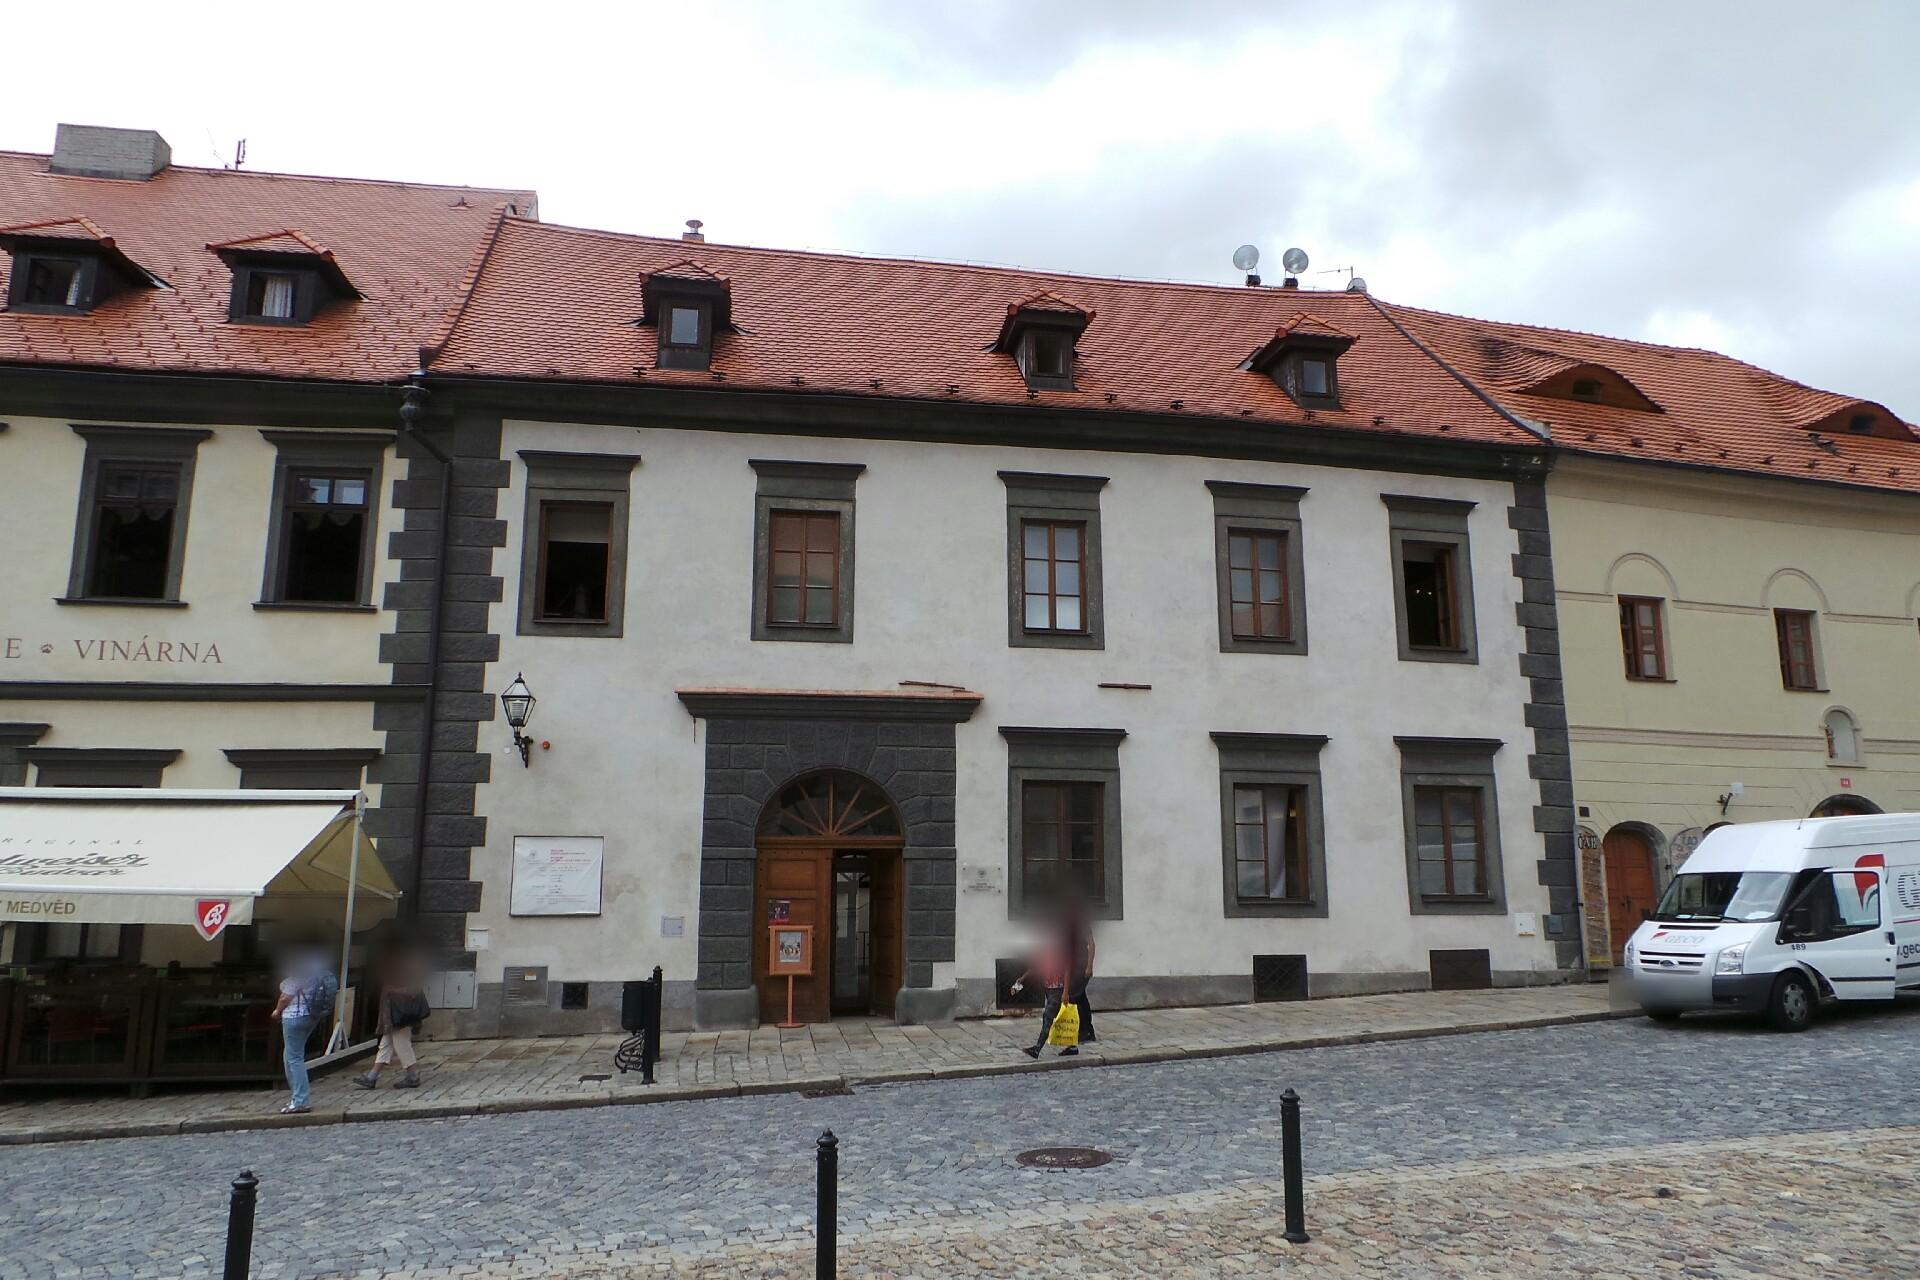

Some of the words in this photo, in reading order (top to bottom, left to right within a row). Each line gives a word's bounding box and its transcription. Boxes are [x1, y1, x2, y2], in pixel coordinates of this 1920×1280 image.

[5, 637, 22, 659] E
[74, 635, 223, 664] VINÁRNA
[6, 899, 76, 915] MEDVĚD
